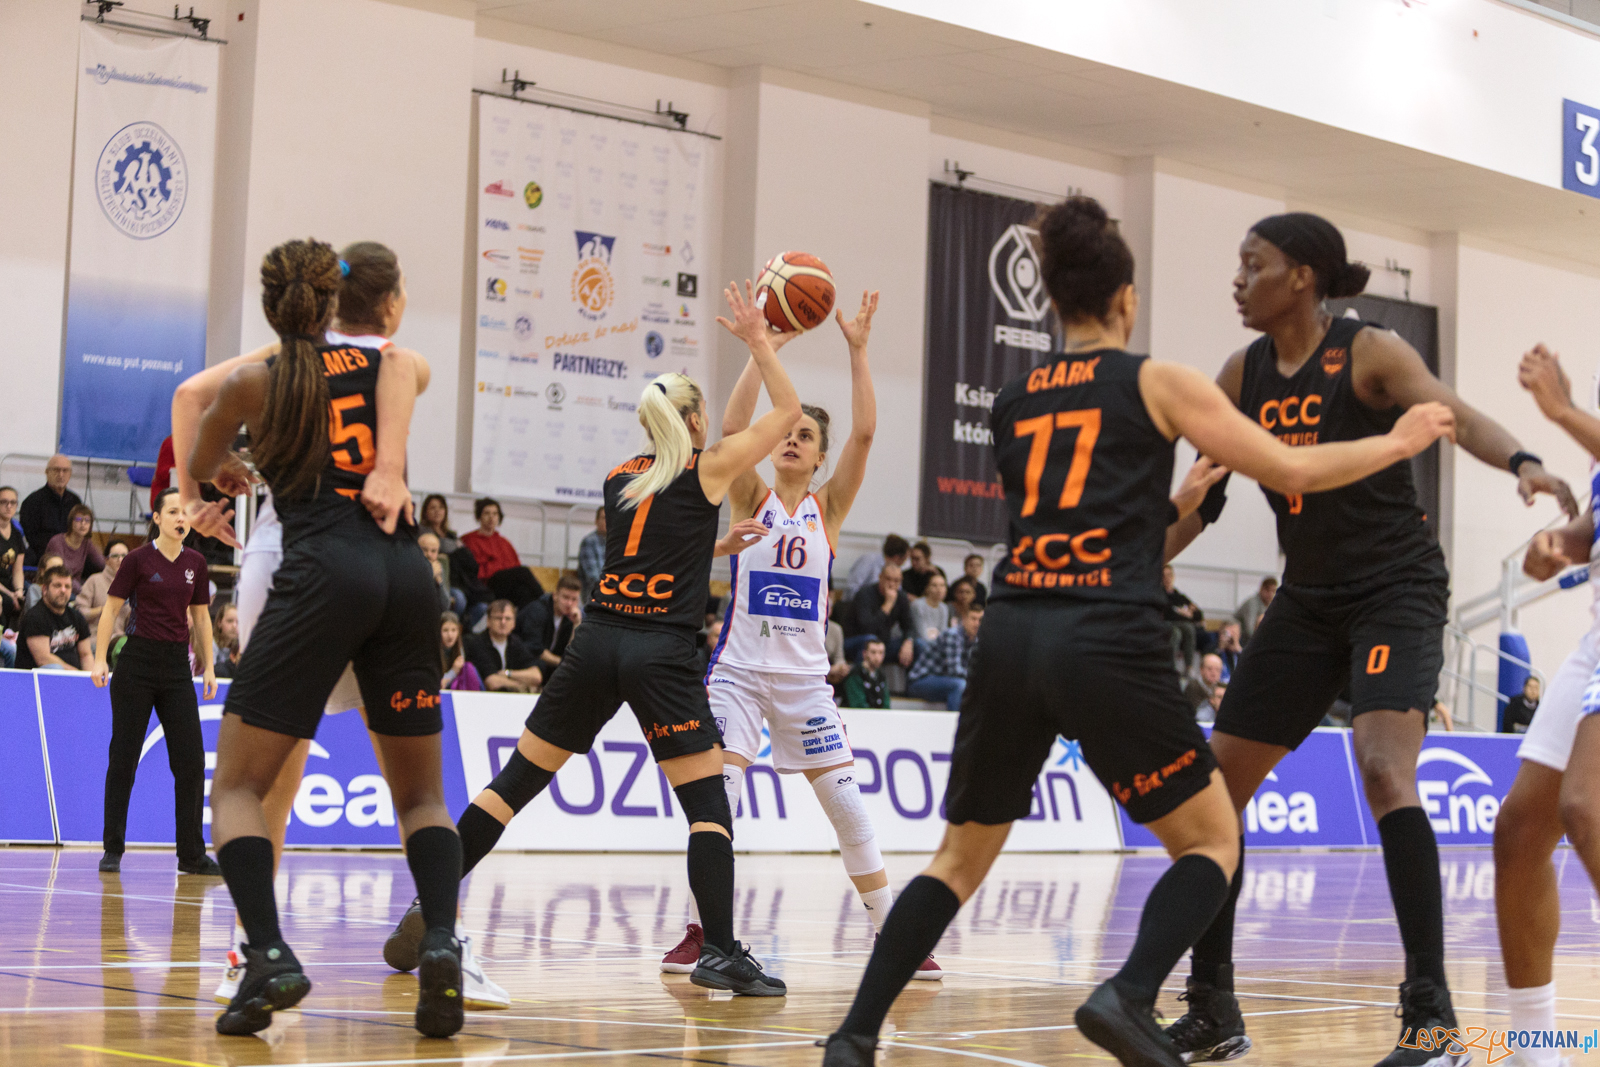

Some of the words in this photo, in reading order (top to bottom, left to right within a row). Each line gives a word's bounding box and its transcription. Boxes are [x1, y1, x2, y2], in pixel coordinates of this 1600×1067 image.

[1575, 112, 1600, 187] 3
[994, 325, 1052, 352] REBIS
[322, 348, 370, 377] MES
[553, 352, 628, 379] PARTNERZY:
[1026, 356, 1101, 394] CLARK
[1259, 394, 1323, 430] CCC
[1014, 408, 1102, 518] 77
[937, 477, 1006, 500] www.r
[771, 534, 808, 570] 16
[1012, 528, 1112, 571] CCC
[599, 573, 675, 600] CCC
[764, 591, 812, 610] Enea
[772, 625, 806, 634] AVENIDA
[1366, 644, 1391, 675] 0
[1246, 791, 1320, 834] ea
[1417, 780, 1508, 835] Ene
